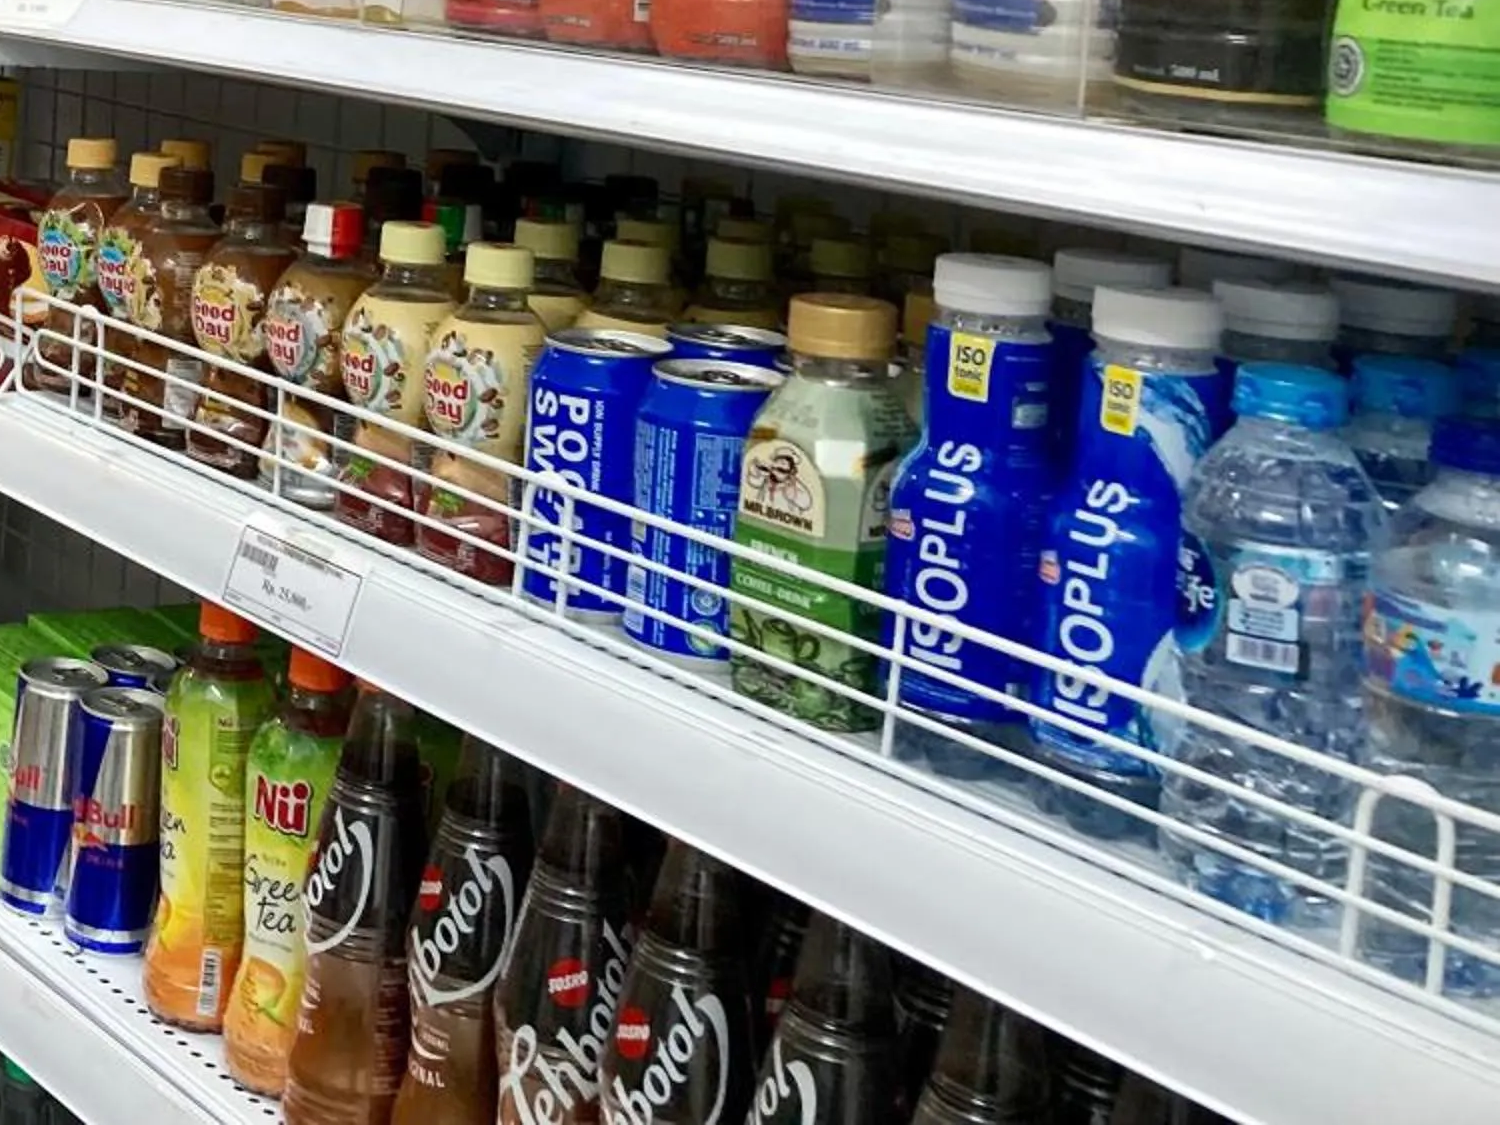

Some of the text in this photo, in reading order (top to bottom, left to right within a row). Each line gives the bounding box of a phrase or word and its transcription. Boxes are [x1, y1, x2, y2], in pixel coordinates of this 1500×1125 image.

[954, 365, 983, 383] tonic
[956, 345, 986, 366] ISO
[1108, 378, 1135, 401] ISO
[908, 439, 982, 671] ISOPLUS
[1052, 478, 1132, 728] ISOPLUS
[88, 798, 138, 829] Bull
[254, 774, 314, 837] Nü
[245, 852, 301, 902] Gree
